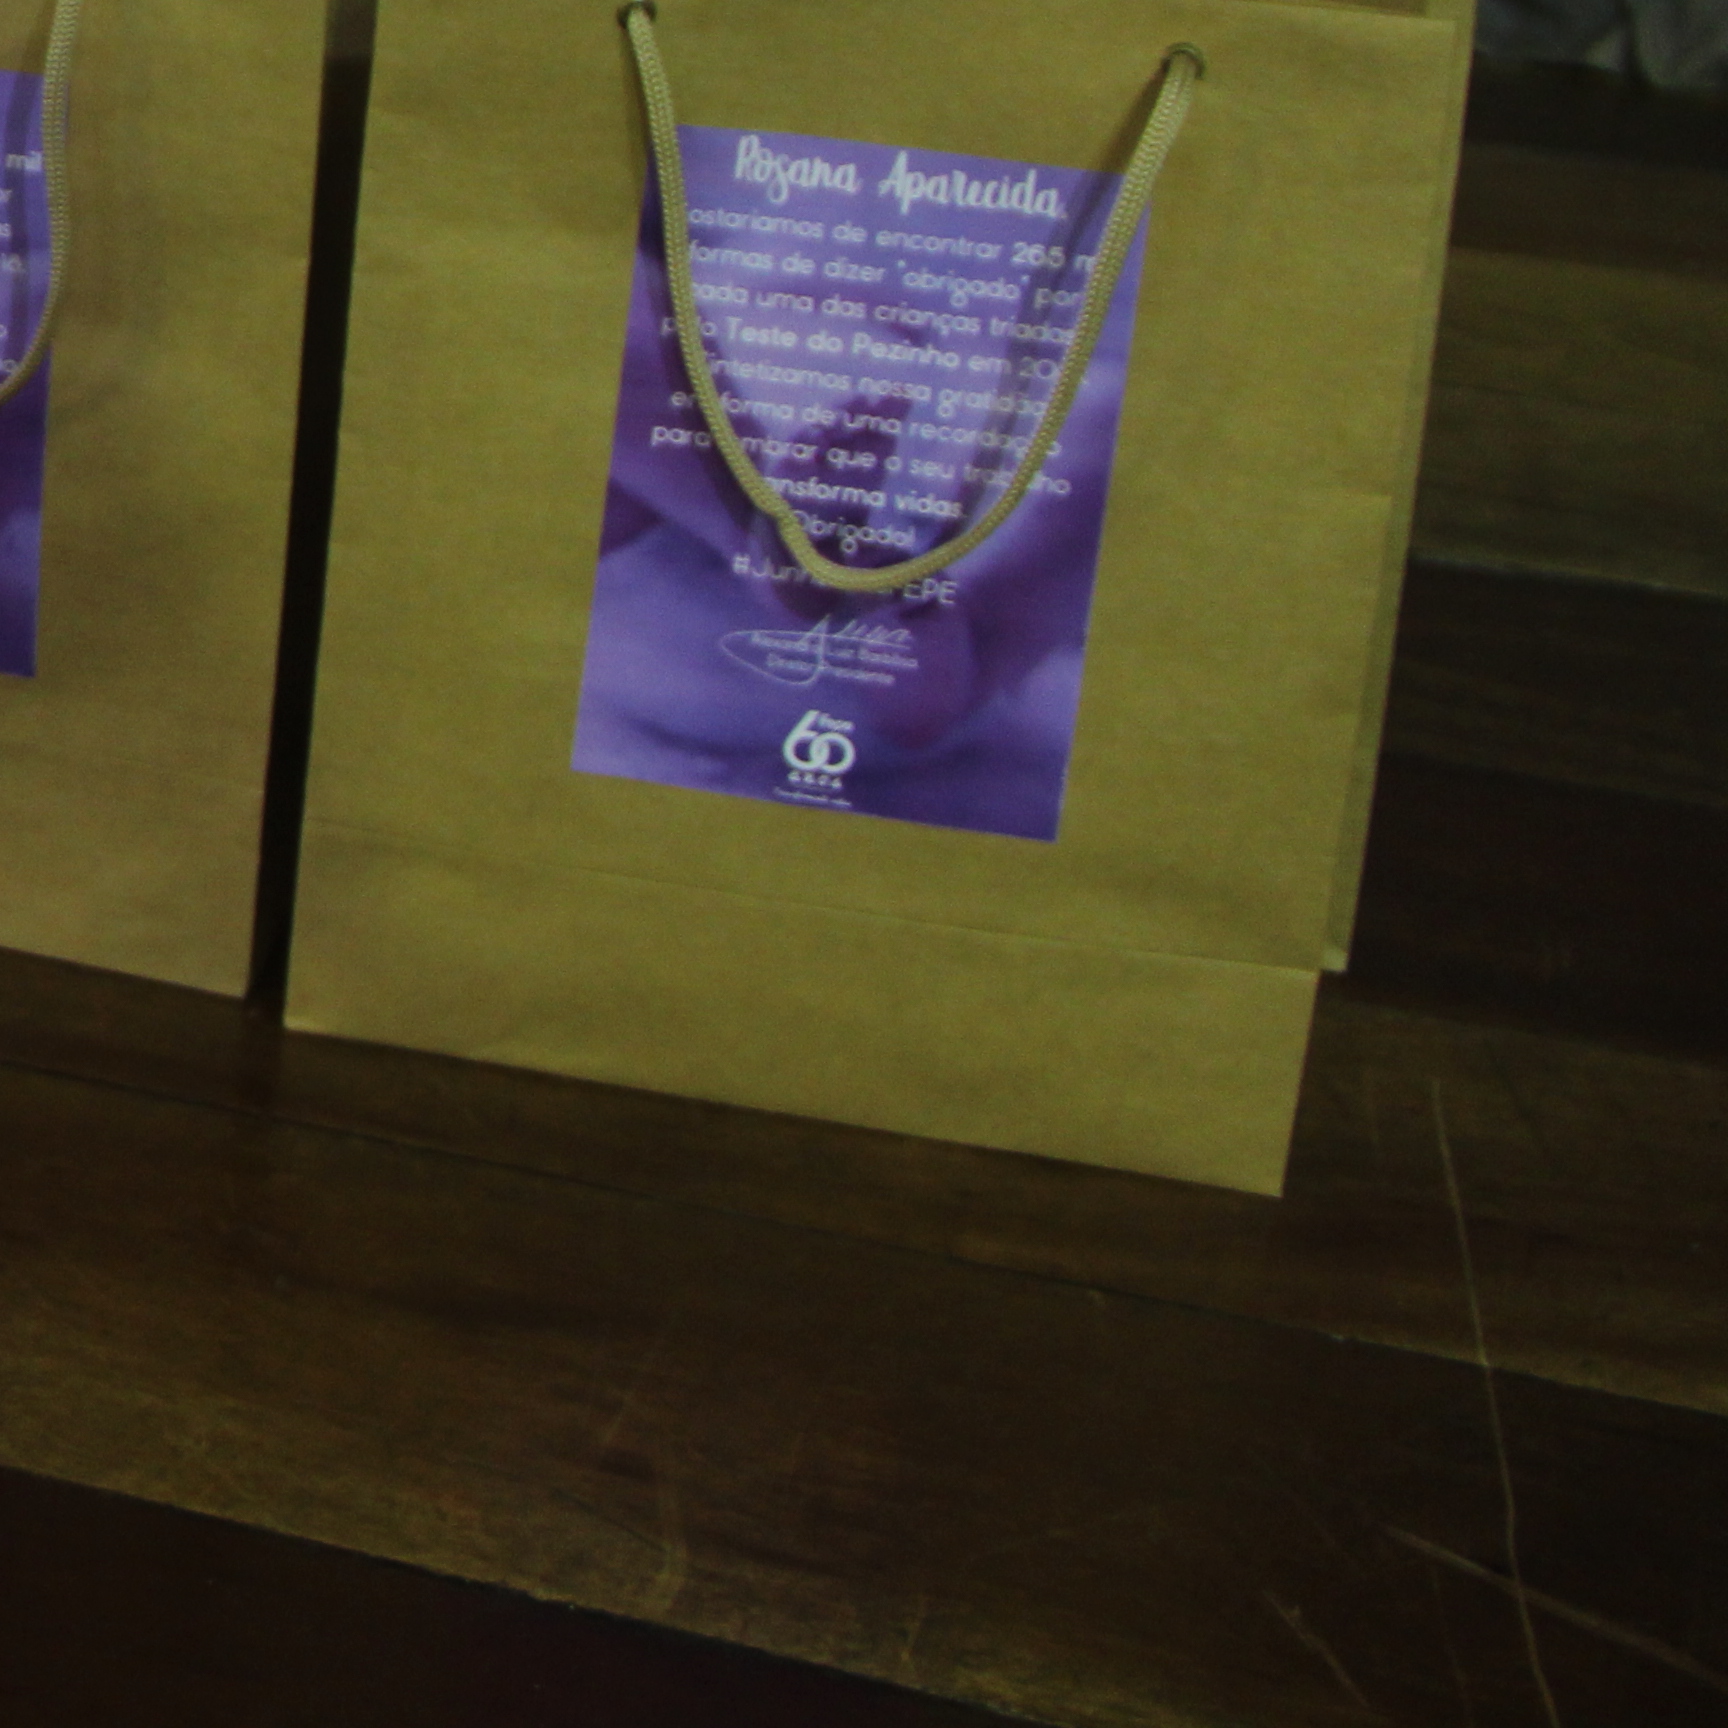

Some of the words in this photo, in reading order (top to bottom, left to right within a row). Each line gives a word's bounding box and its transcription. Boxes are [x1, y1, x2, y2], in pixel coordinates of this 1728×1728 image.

[782, 253, 816, 273] de
[832, 221, 868, 241] de
[876, 229, 1003, 258] encontrar
[1011, 240, 1066, 268] 265
[727, 316, 798, 347] Teste
[806, 328, 844, 350] do
[852, 331, 961, 367] Pezinho
[908, 421, 1062, 457] recordaço
[783, 709, 857, 772] 60
